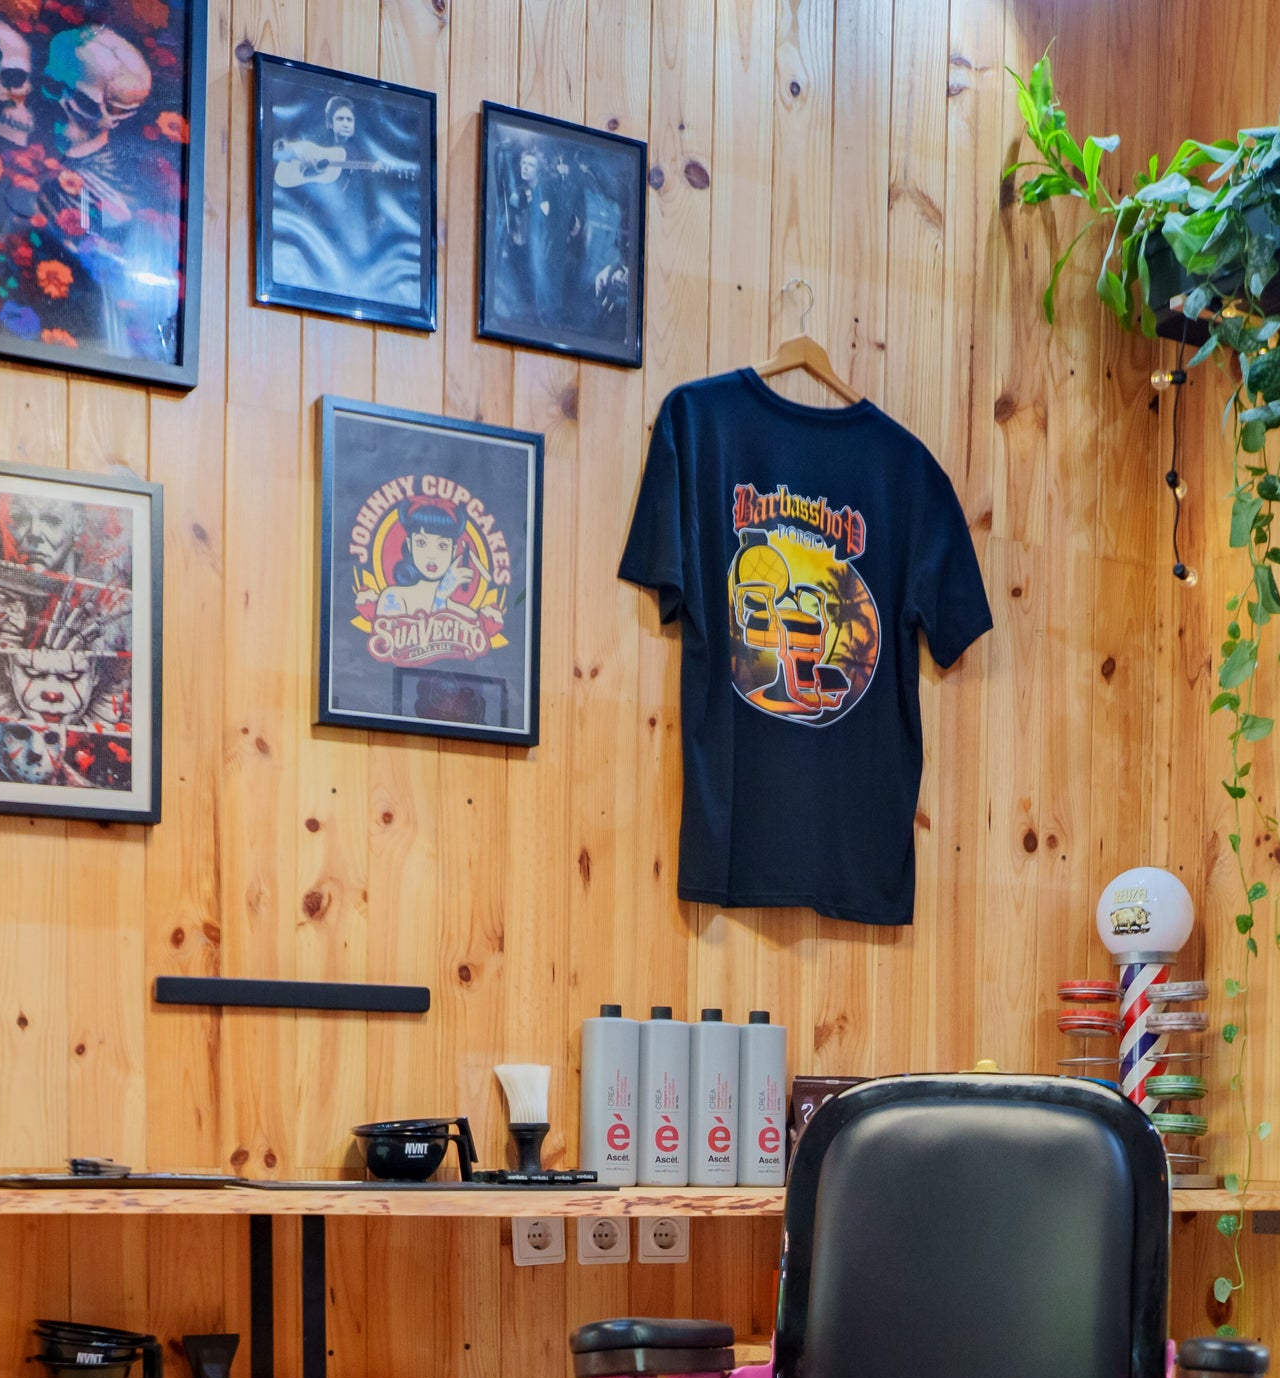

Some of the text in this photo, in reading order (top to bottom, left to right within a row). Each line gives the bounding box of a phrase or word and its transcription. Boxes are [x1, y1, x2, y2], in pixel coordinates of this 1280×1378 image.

[349, 474, 511, 586] JOHNNY CUPCAKES
[777, 523, 826, 550] PORTO
[404, 1142, 429, 1154] NVNT
[76, 1352, 104, 1364] NVNT
